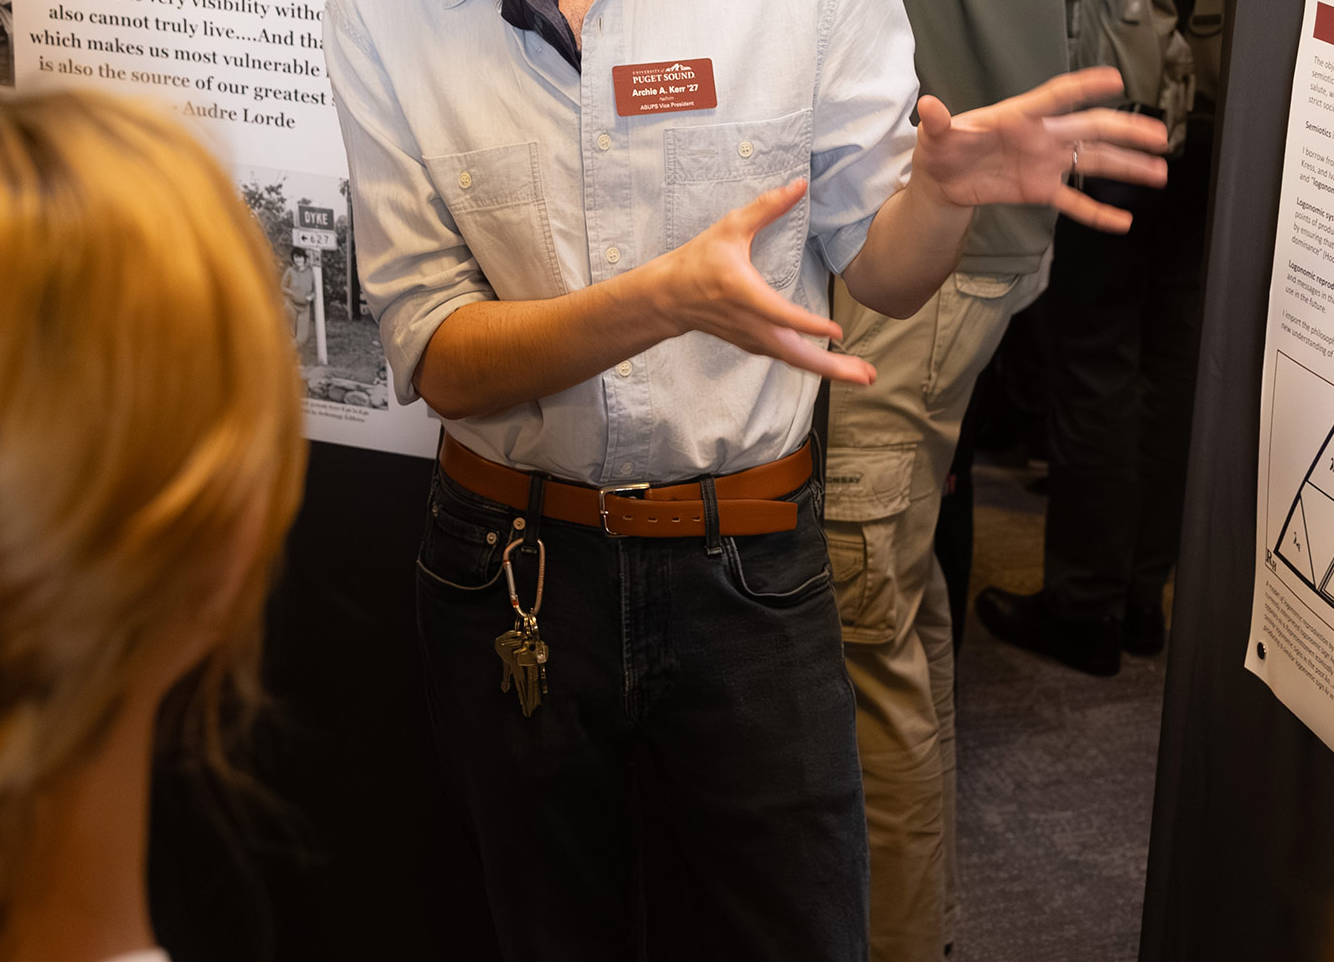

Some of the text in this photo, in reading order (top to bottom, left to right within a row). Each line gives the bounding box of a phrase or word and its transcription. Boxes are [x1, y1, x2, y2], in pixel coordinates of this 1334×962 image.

[275, 3, 323, 22] witho
[49, 5, 83, 23] also
[89, 11, 149, 30] cannot
[155, 17, 198, 38] truly
[300, 33, 323, 50] tha
[30, 30, 320, 77] which makes us most vulnerable
[39, 55, 326, 106] is also the source of our greatest
[633, 71, 695, 84] PUGET SOUND
[632, 88, 657, 97] Archie
[672, 100, 694, 108] President
[182, 100, 237, 122] Audre
[243, 108, 295, 129] Lorde
[1305, 121, 1331, 138] Semiotics
[304, 210, 328, 225] DYKE
